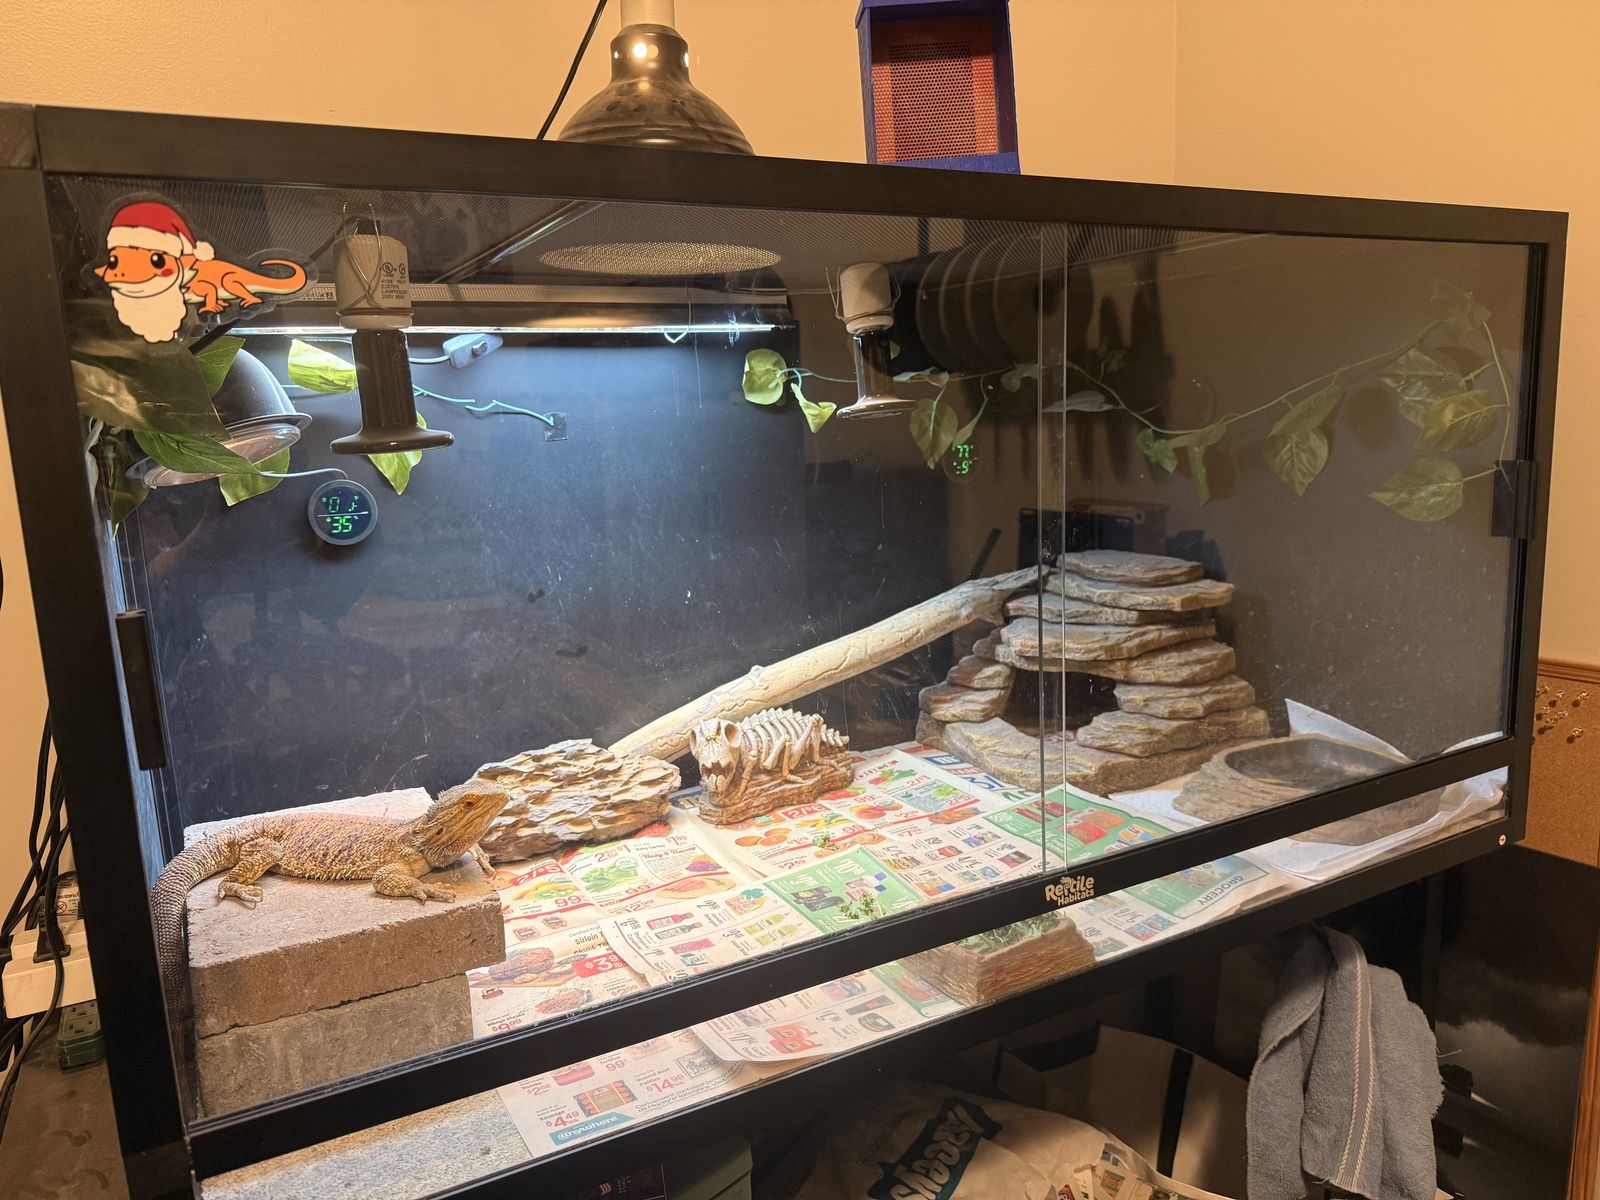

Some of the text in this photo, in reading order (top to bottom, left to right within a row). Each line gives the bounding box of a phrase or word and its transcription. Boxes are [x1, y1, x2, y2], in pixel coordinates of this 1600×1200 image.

[331, 515, 353, 534] 35
[1045, 875, 1095, 902] Reptile
[1056, 888, 1095, 906] Habitats
[1199, 875, 1246, 906] GROCERY
[575, 932, 599, 946] Sirloin
